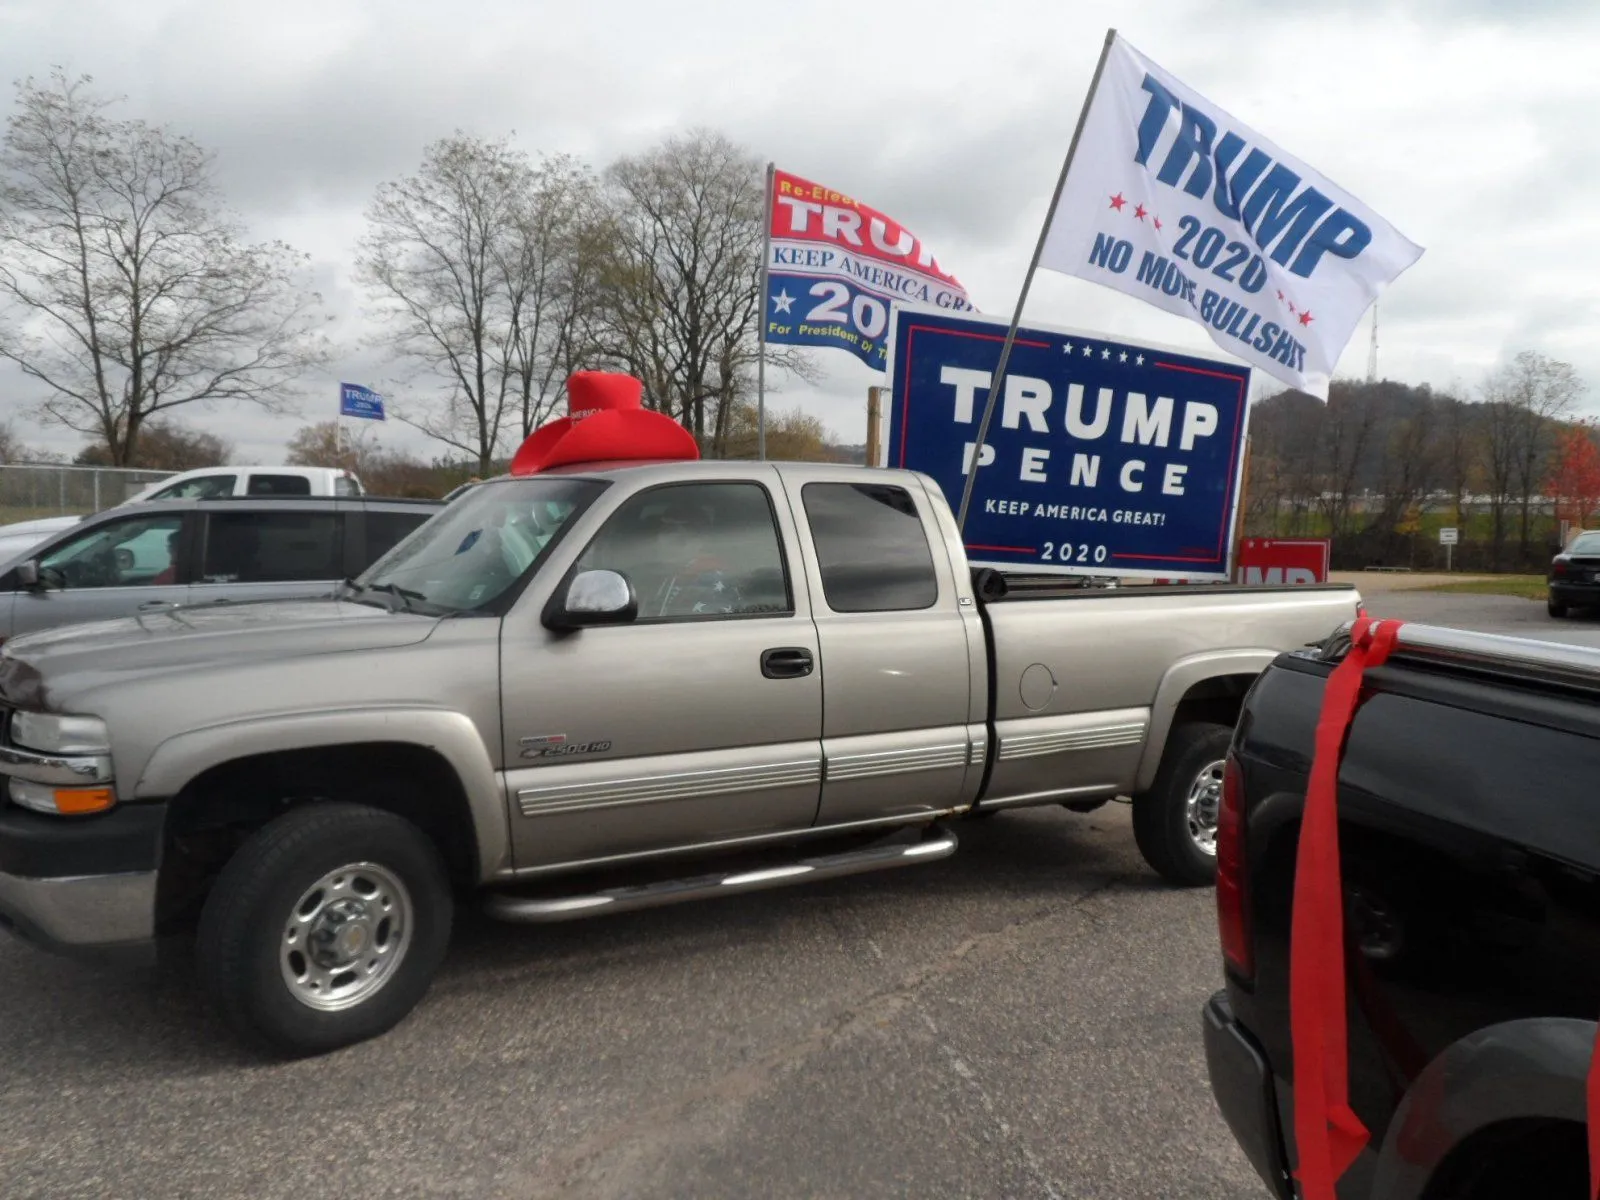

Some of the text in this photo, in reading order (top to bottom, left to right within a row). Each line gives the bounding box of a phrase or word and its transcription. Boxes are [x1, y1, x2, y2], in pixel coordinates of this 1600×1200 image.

[1134, 72, 1372, 279] TRUMP
[774, 247, 834, 268] KEEP
[840, 257, 929, 303] AMERICA
[1172, 215, 1268, 294] 2020
[806, 281, 888, 343] 20
[1088, 233, 1133, 274] NO
[1201, 288, 1307, 372] BULLSHIT
[769, 322, 792, 335] For
[799, 324, 858, 344] President
[344, 389, 382, 404] TRUMP
[940, 366, 1219, 451] TRUMP
[961, 442, 1188, 496] PENCE
[986, 499, 1166, 527] KEEP AMERICA GREAT!
[1041, 542, 1107, 564] 2020
